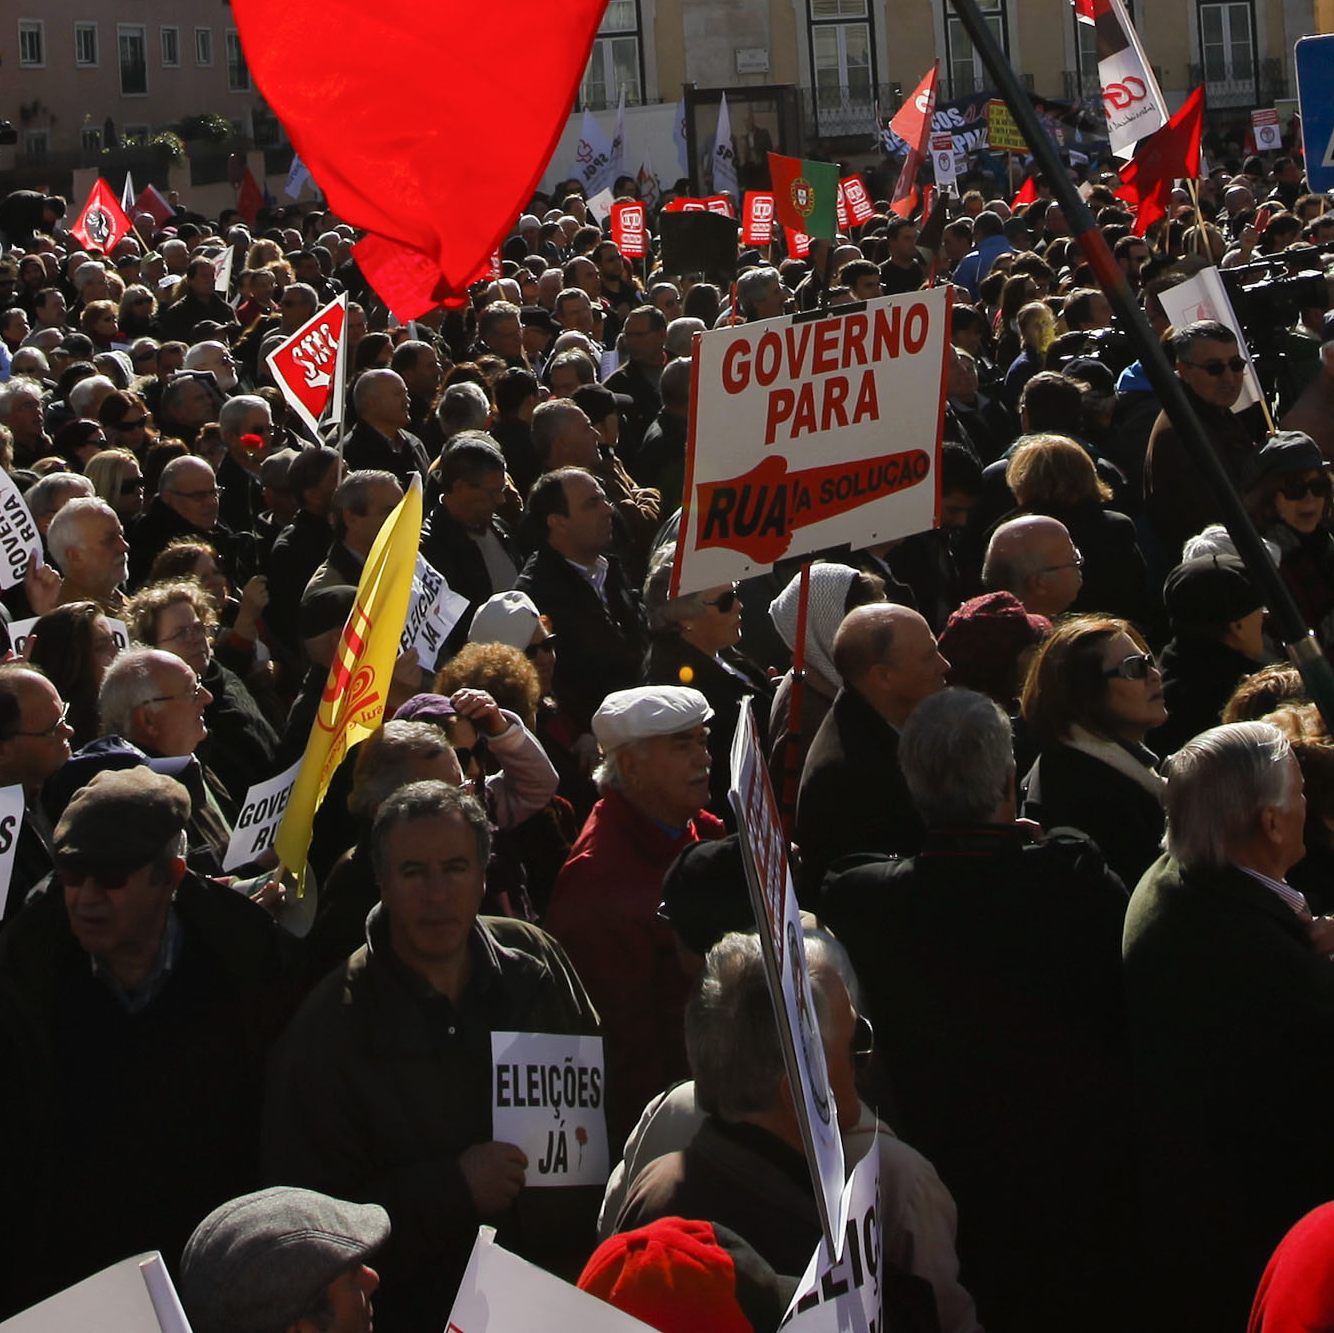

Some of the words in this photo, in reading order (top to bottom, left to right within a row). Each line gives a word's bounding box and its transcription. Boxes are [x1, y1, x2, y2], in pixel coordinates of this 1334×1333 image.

[722, 302, 929, 395] GOVERNO
[764, 369, 880, 446] PARA
[4, 493, 36, 543] RUA
[795, 485, 812, 513] A
[495, 1055, 601, 1120] ELEIÇÕES
[538, 1119, 568, 1175] JÁ
